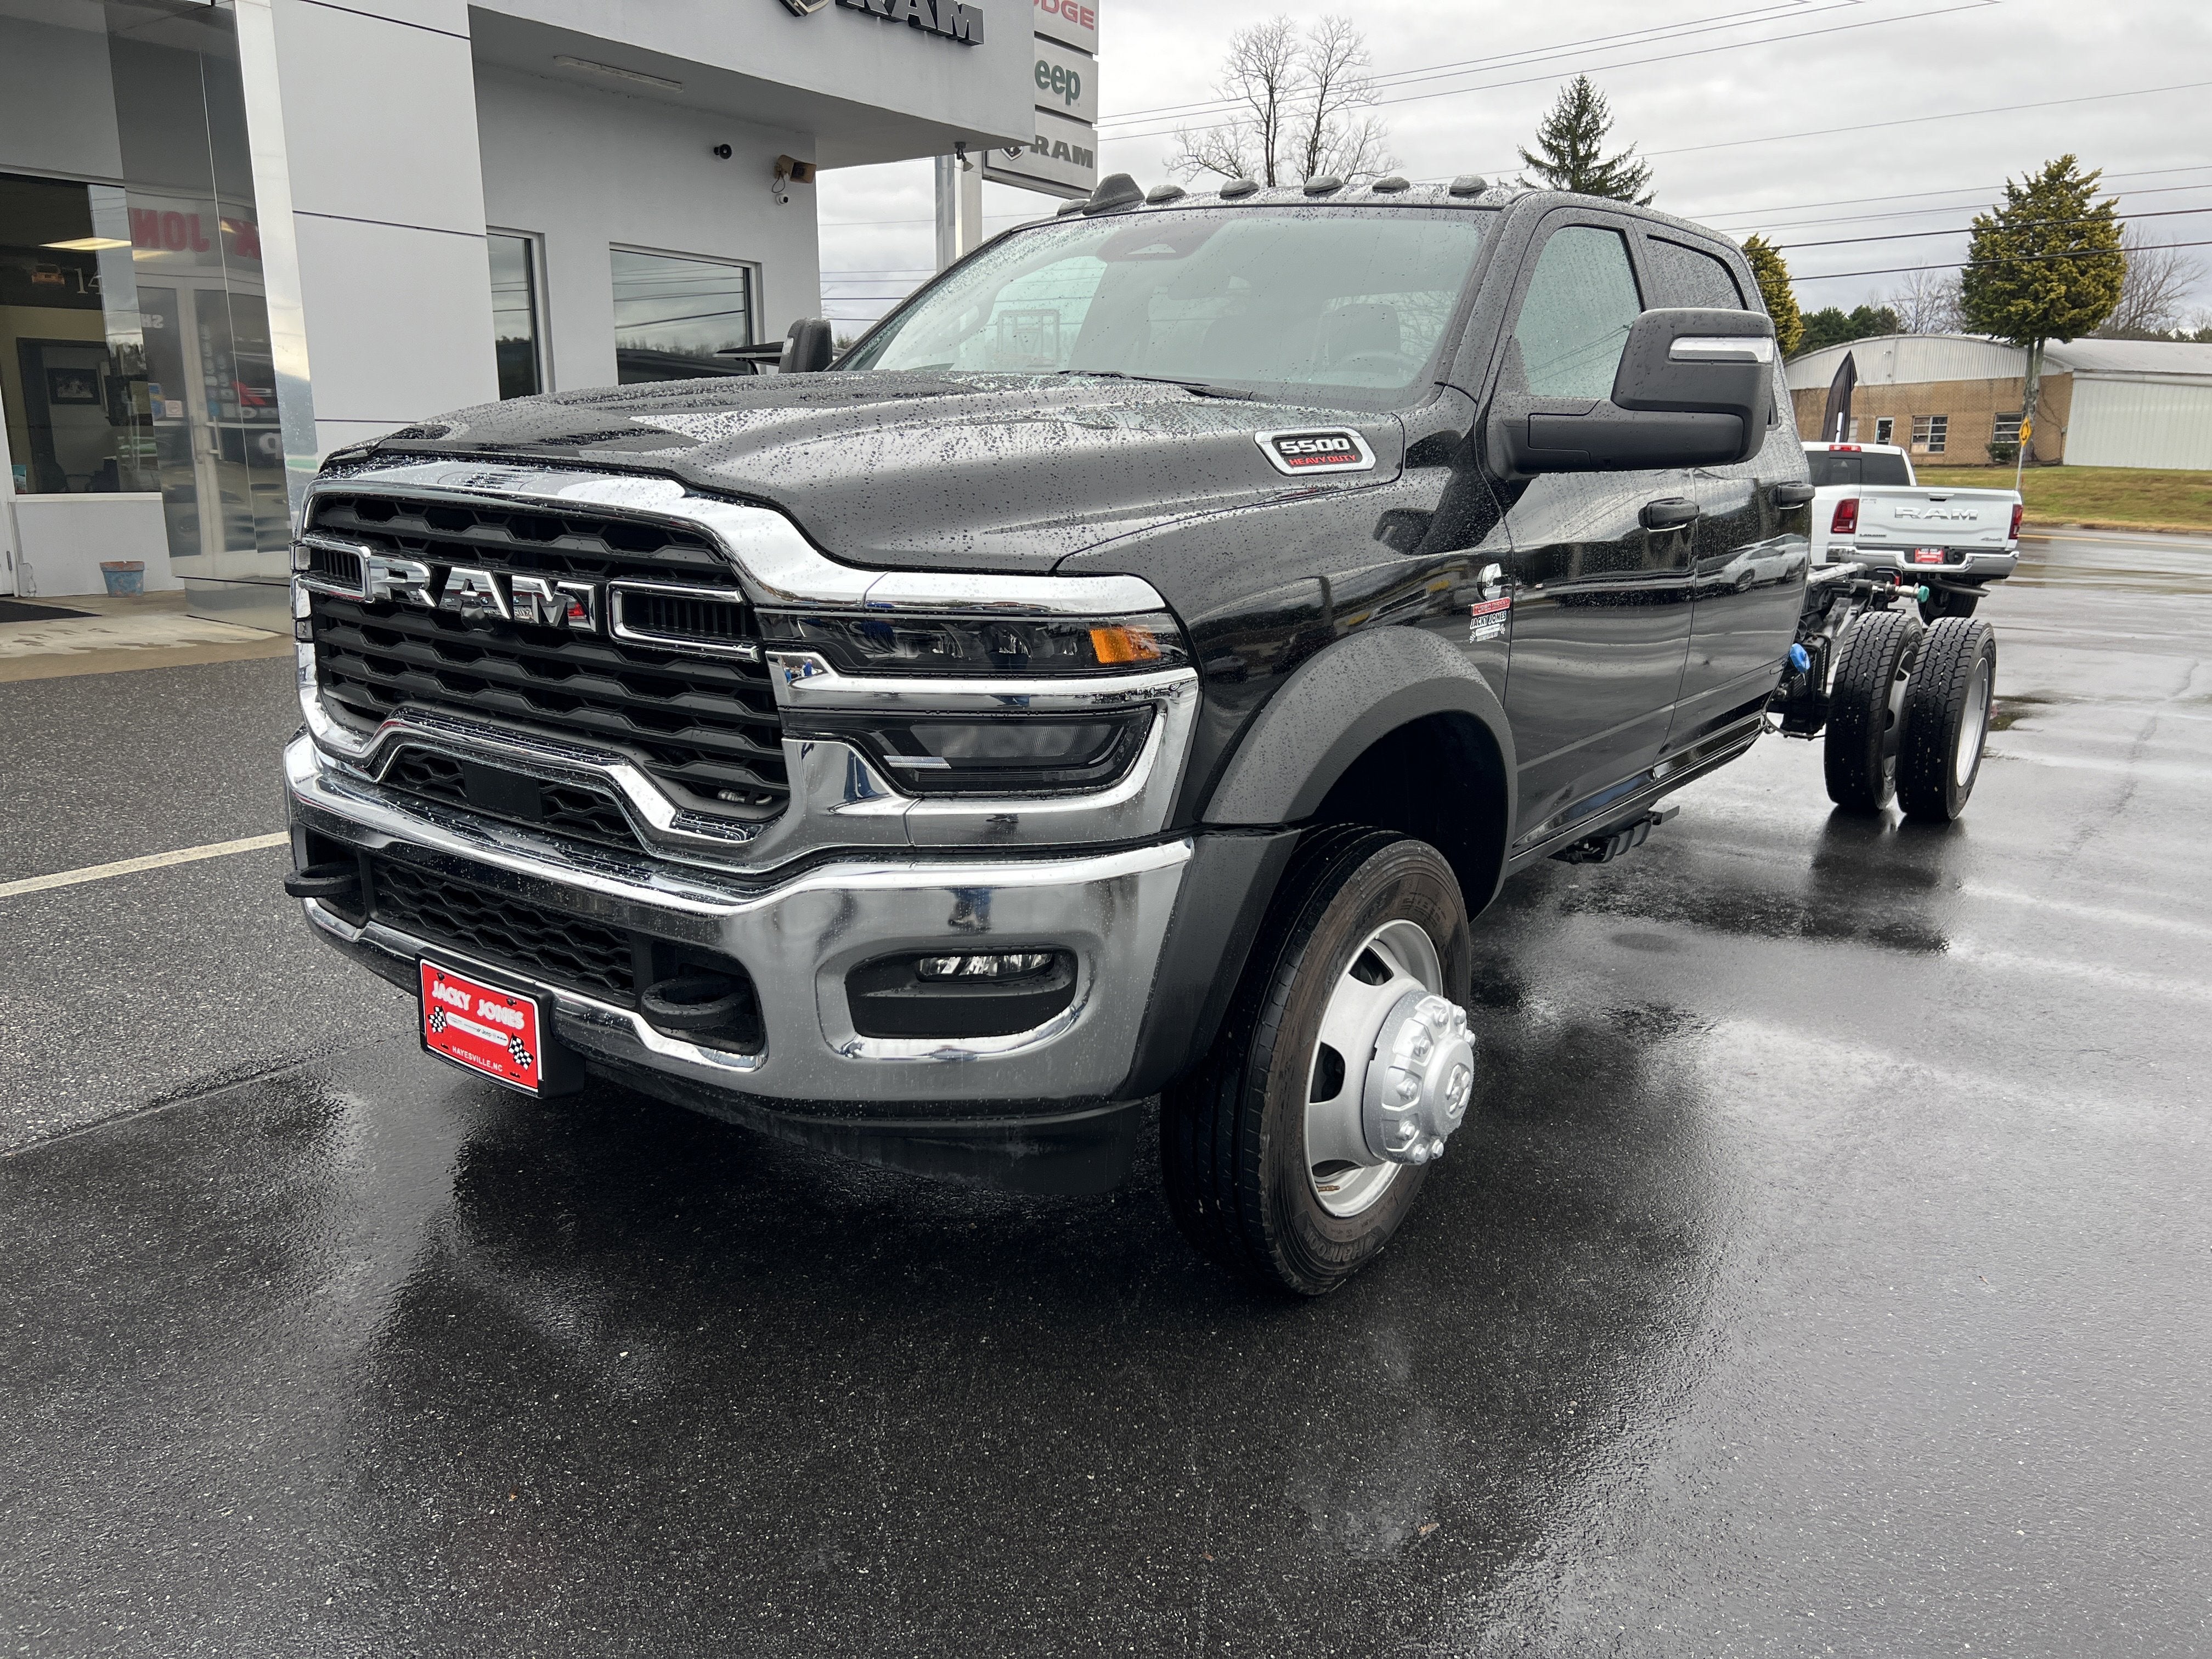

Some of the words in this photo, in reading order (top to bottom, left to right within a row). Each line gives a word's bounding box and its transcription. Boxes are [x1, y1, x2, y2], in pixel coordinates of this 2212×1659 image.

[1030, 135, 1093, 169] RAM
[1279, 438, 1350, 454] 5500
[1289, 456, 1326, 465] HEAVY
[1895, 506, 1978, 521] RAM
[370, 554, 596, 632] RAM
[1470, 615, 1489, 629] JACKY
[1488, 611, 1506, 625] JONES
[432, 980, 471, 1011] JACKY
[477, 999, 524, 1030] JONES
